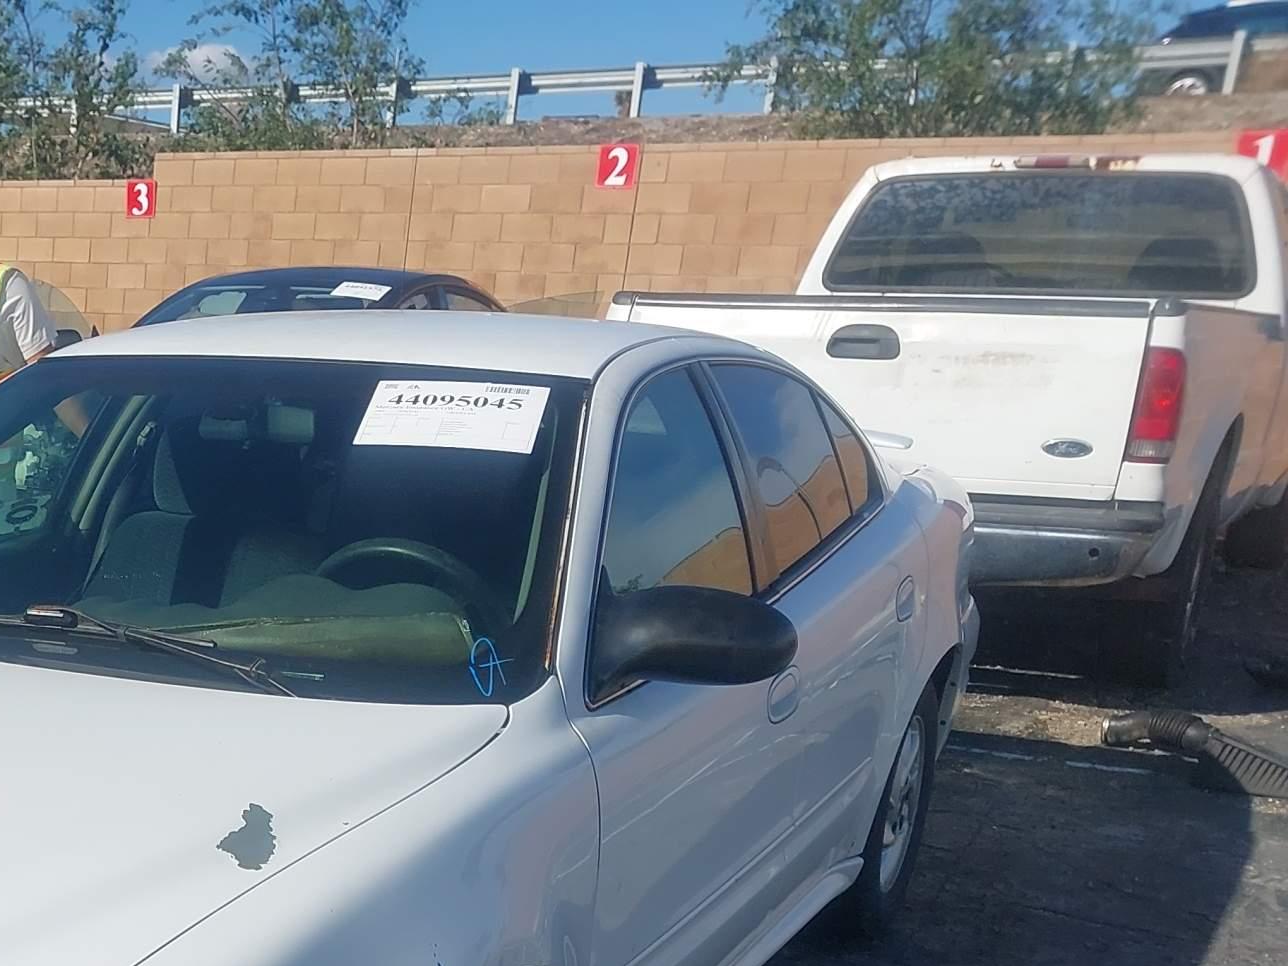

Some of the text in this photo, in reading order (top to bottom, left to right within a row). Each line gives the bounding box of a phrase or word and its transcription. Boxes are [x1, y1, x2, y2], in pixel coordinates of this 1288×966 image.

[1253, 134, 1276, 166] 1
[604, 147, 630, 186] 2
[131, 183, 149, 215] 3
[387, 393, 524, 411] 44095045
